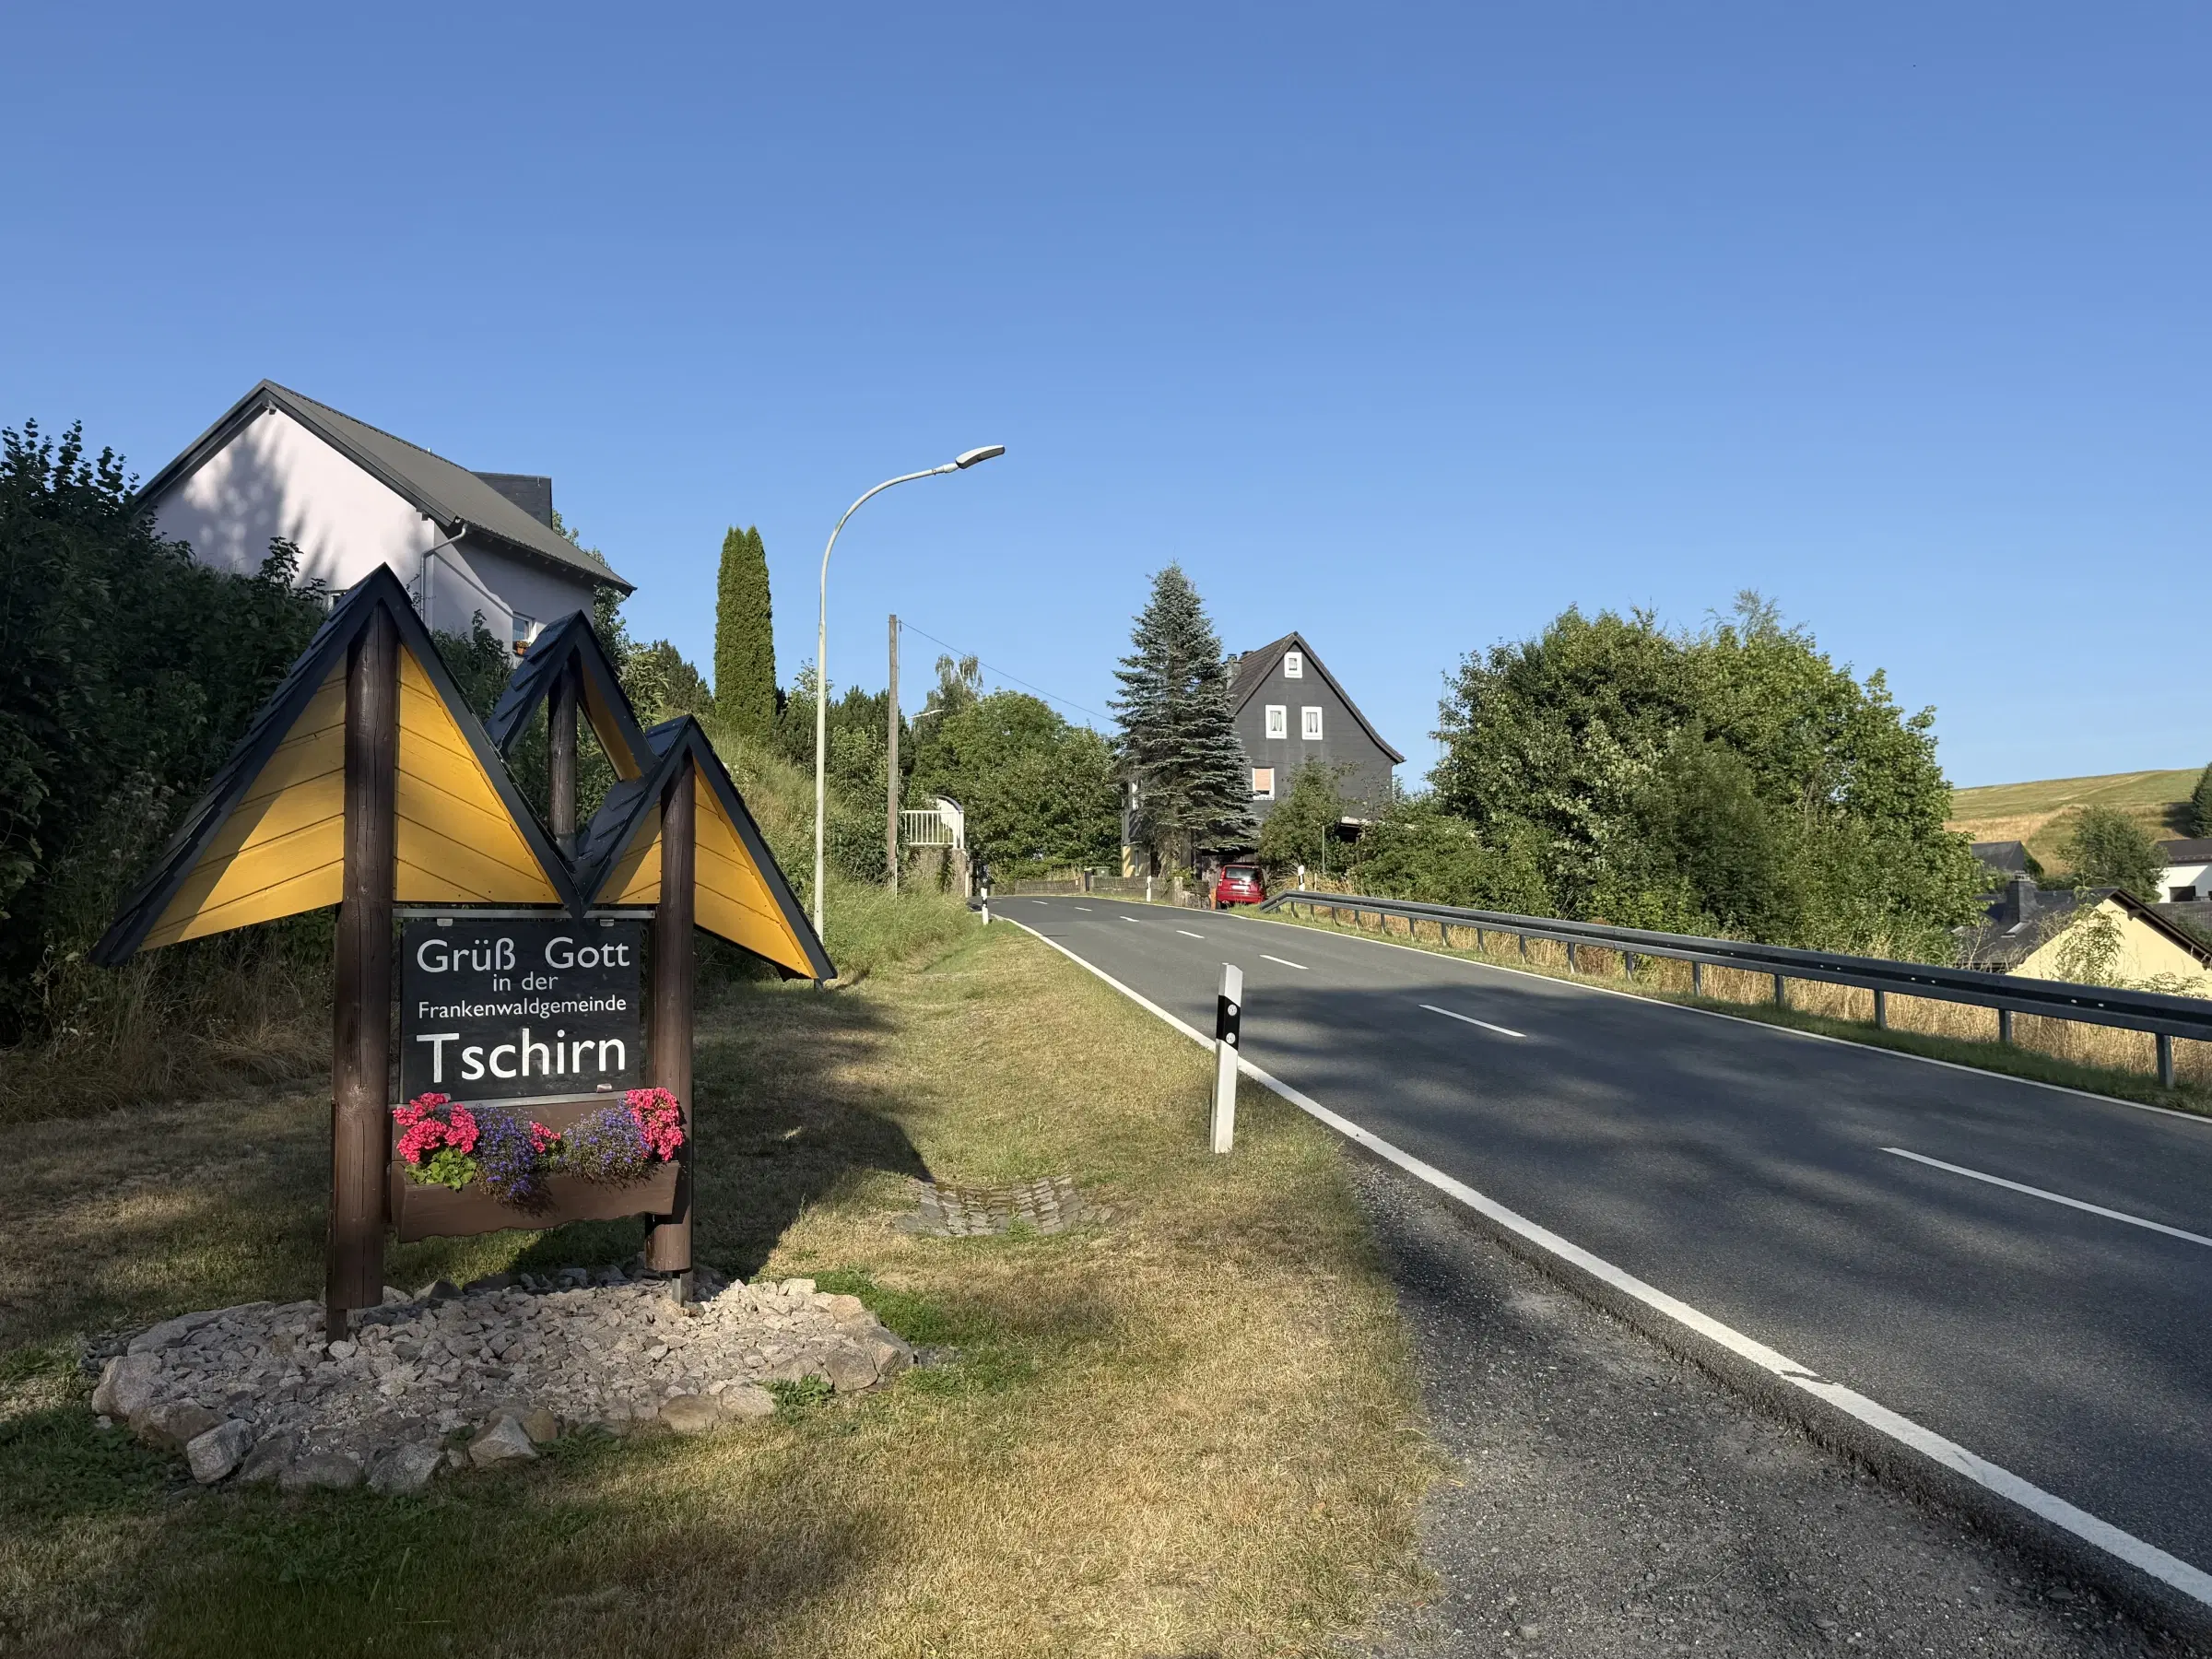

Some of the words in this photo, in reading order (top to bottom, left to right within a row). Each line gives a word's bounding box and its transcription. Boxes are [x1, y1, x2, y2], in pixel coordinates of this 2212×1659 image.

[417, 937, 516, 972] Grüß
[545, 936, 630, 969] Gott
[492, 973, 512, 992] in
[521, 971, 559, 991] der
[418, 994, 627, 1018] Frankenwaldgemeinde
[416, 1028, 626, 1083] Tschirn
